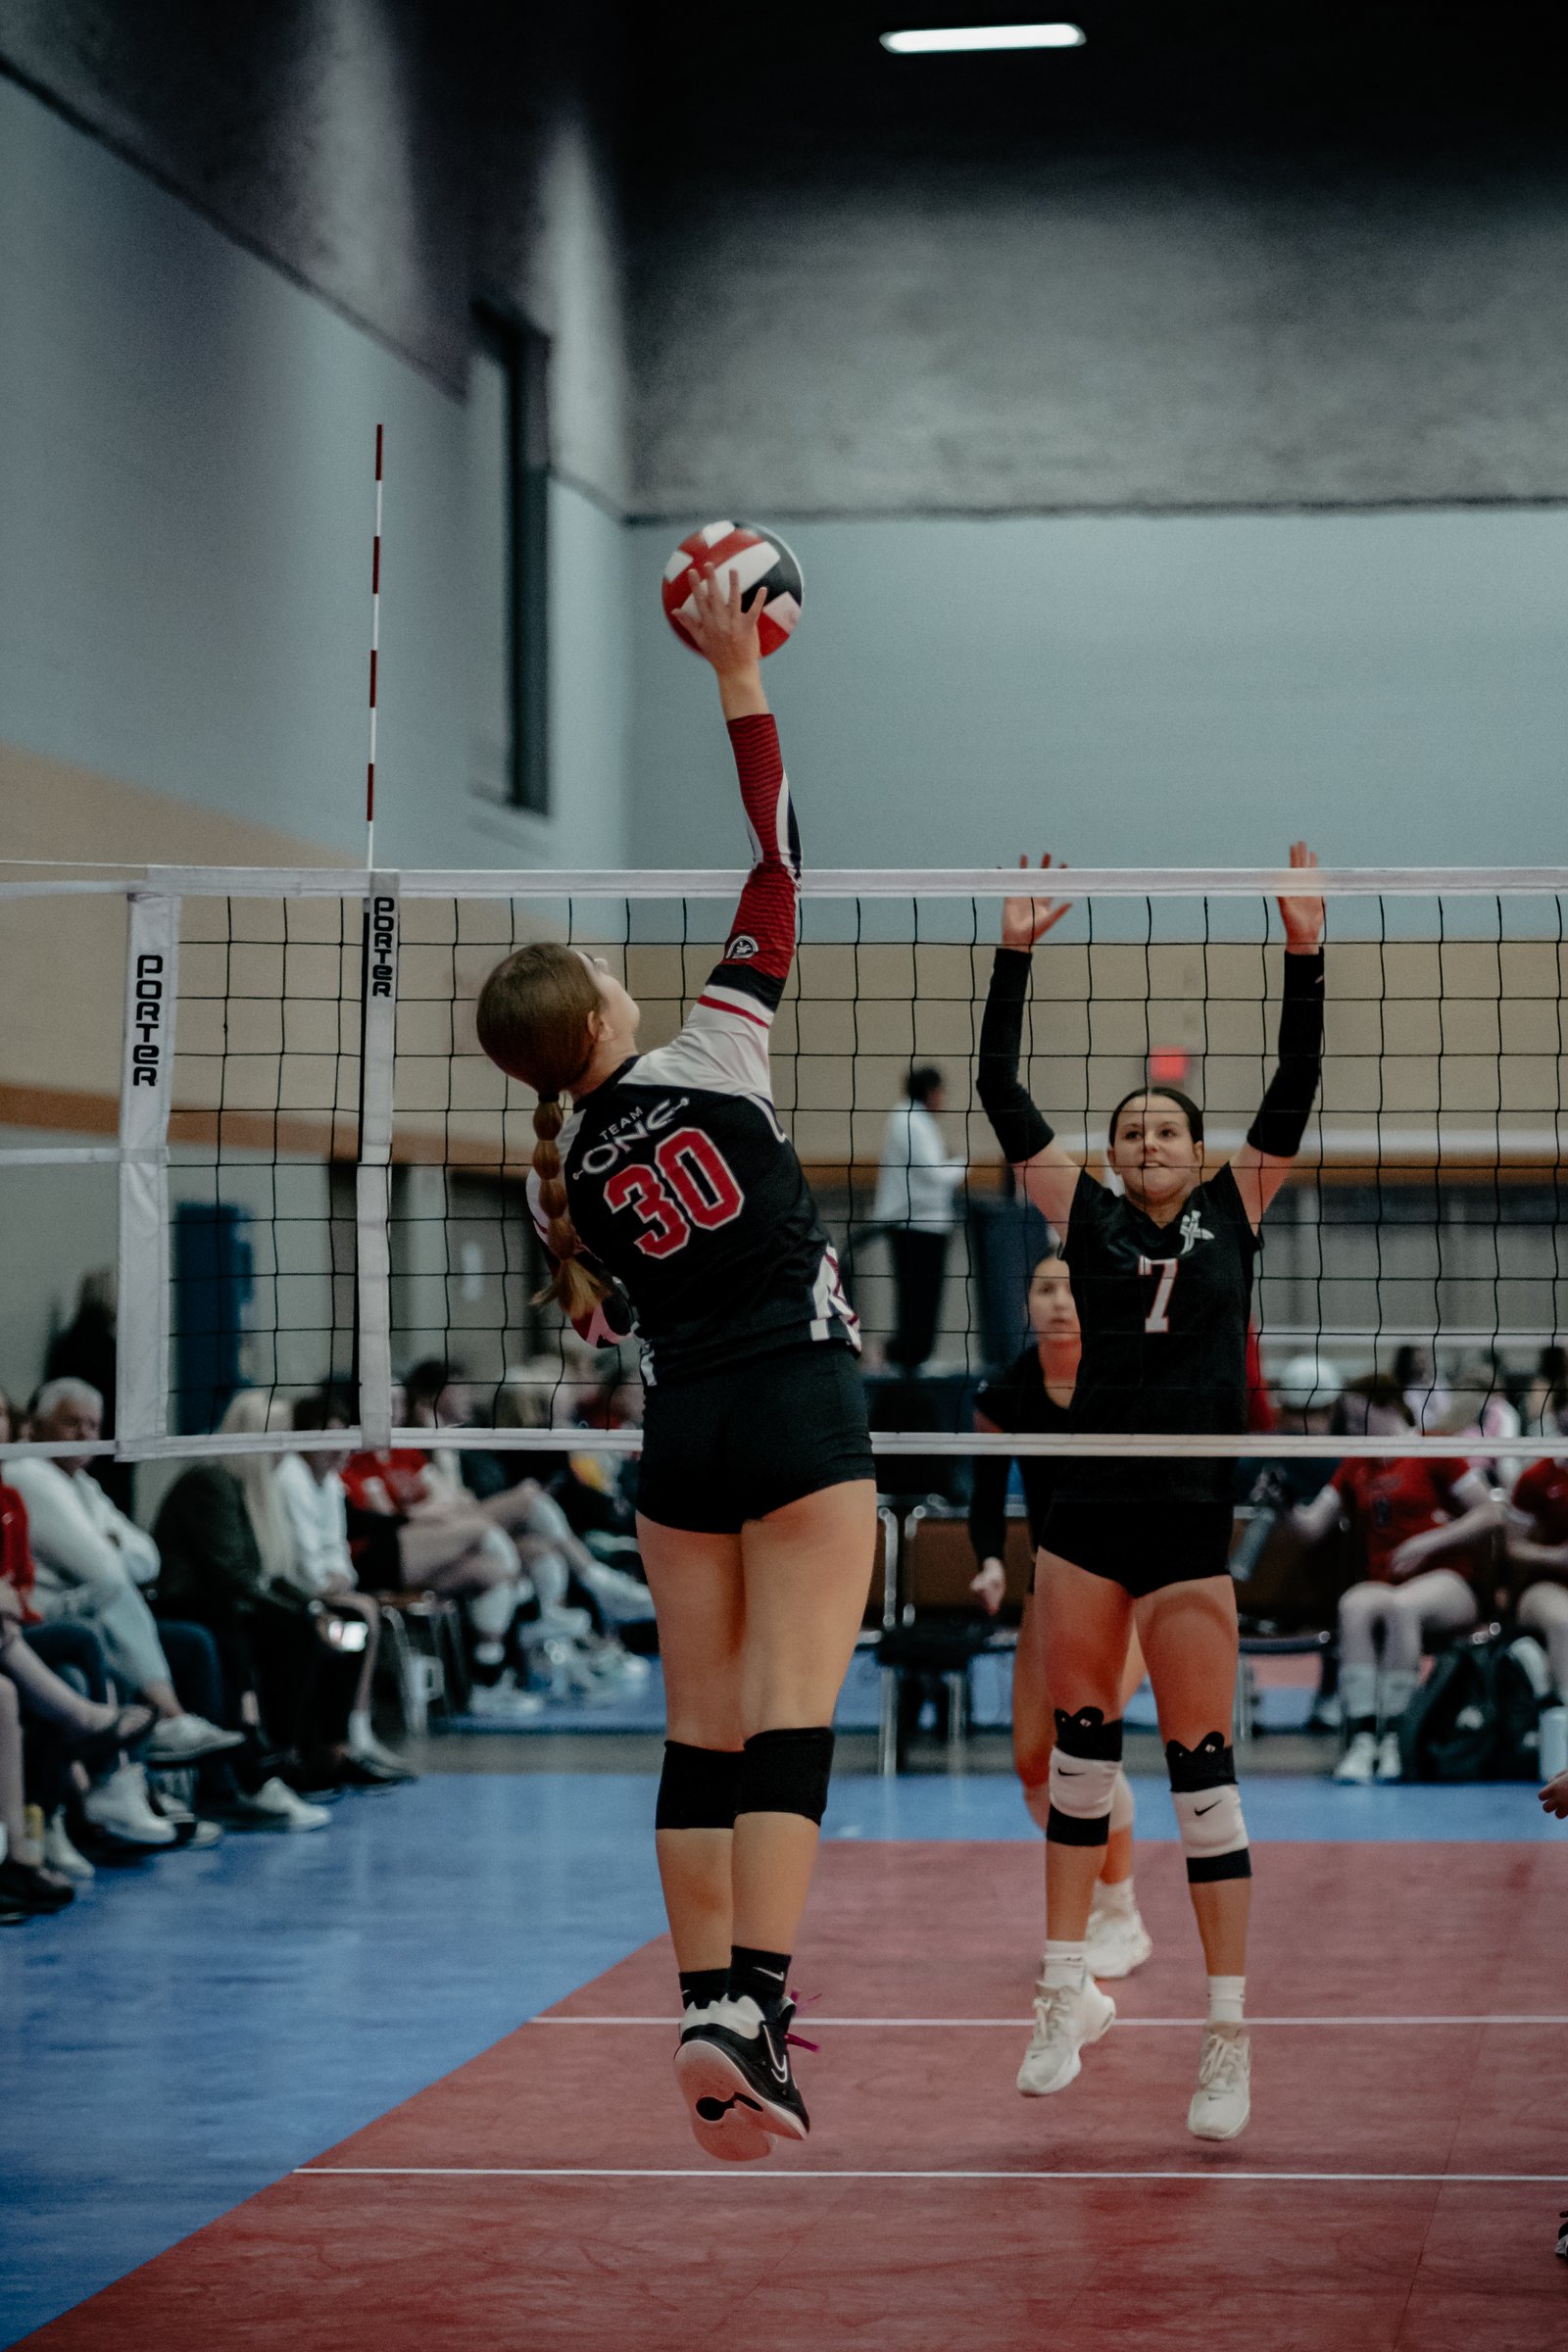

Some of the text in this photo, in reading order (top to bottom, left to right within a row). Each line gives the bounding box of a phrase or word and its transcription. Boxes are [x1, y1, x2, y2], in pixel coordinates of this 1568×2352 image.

[372, 897, 395, 998] PORTER
[133, 955, 164, 1087] PORTER
[580, 1097, 679, 1176] ONE
[600, 1106, 643, 1140] TEAM
[604, 1127, 744, 1259] 30
[1138, 1255, 1179, 1333] 7
